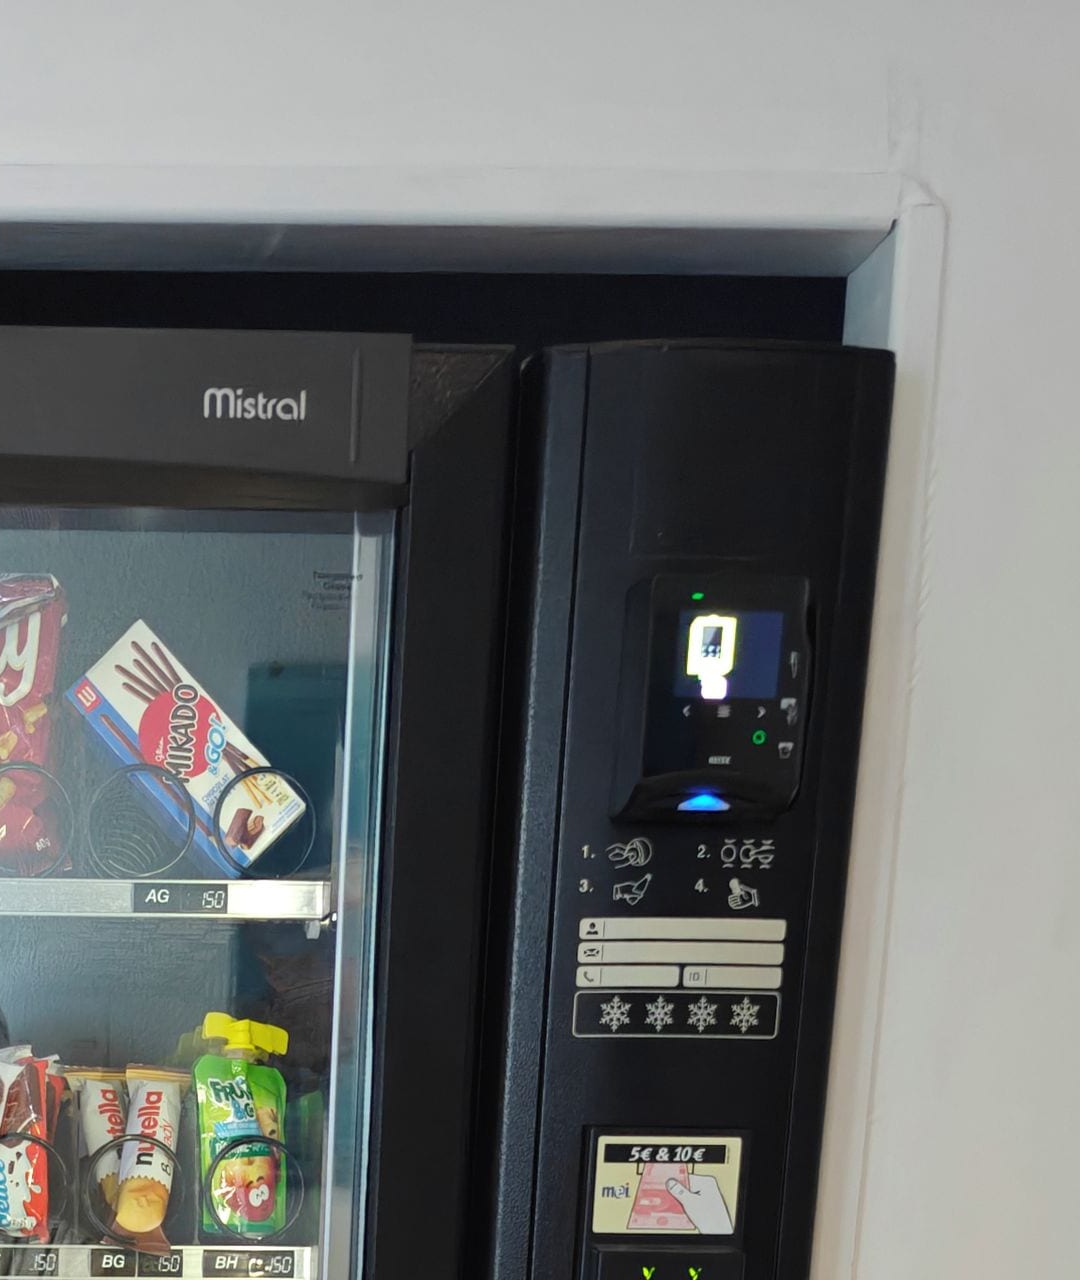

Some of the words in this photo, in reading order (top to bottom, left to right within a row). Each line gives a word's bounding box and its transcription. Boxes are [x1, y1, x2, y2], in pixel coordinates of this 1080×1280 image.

[203, 387, 307, 422] Mistral
[77, 685, 98, 708] LU
[162, 683, 200, 785] MIKADO
[581, 844, 596, 859] 1.
[696, 845, 711, 859] 2.
[579, 879, 594, 893] 3.
[694, 878, 709, 893] 4.
[145, 889, 170, 903] AG
[201, 890, 225, 908] 150
[136, 1090, 164, 1166] nutella
[628, 1146, 653, 1162] 5€
[655, 1147, 670, 1162] &
[34, 1253, 57, 1270] 150
[101, 1255, 125, 1268] BG
[157, 1255, 180, 1272] 150
[215, 1256, 238, 1270] BH
